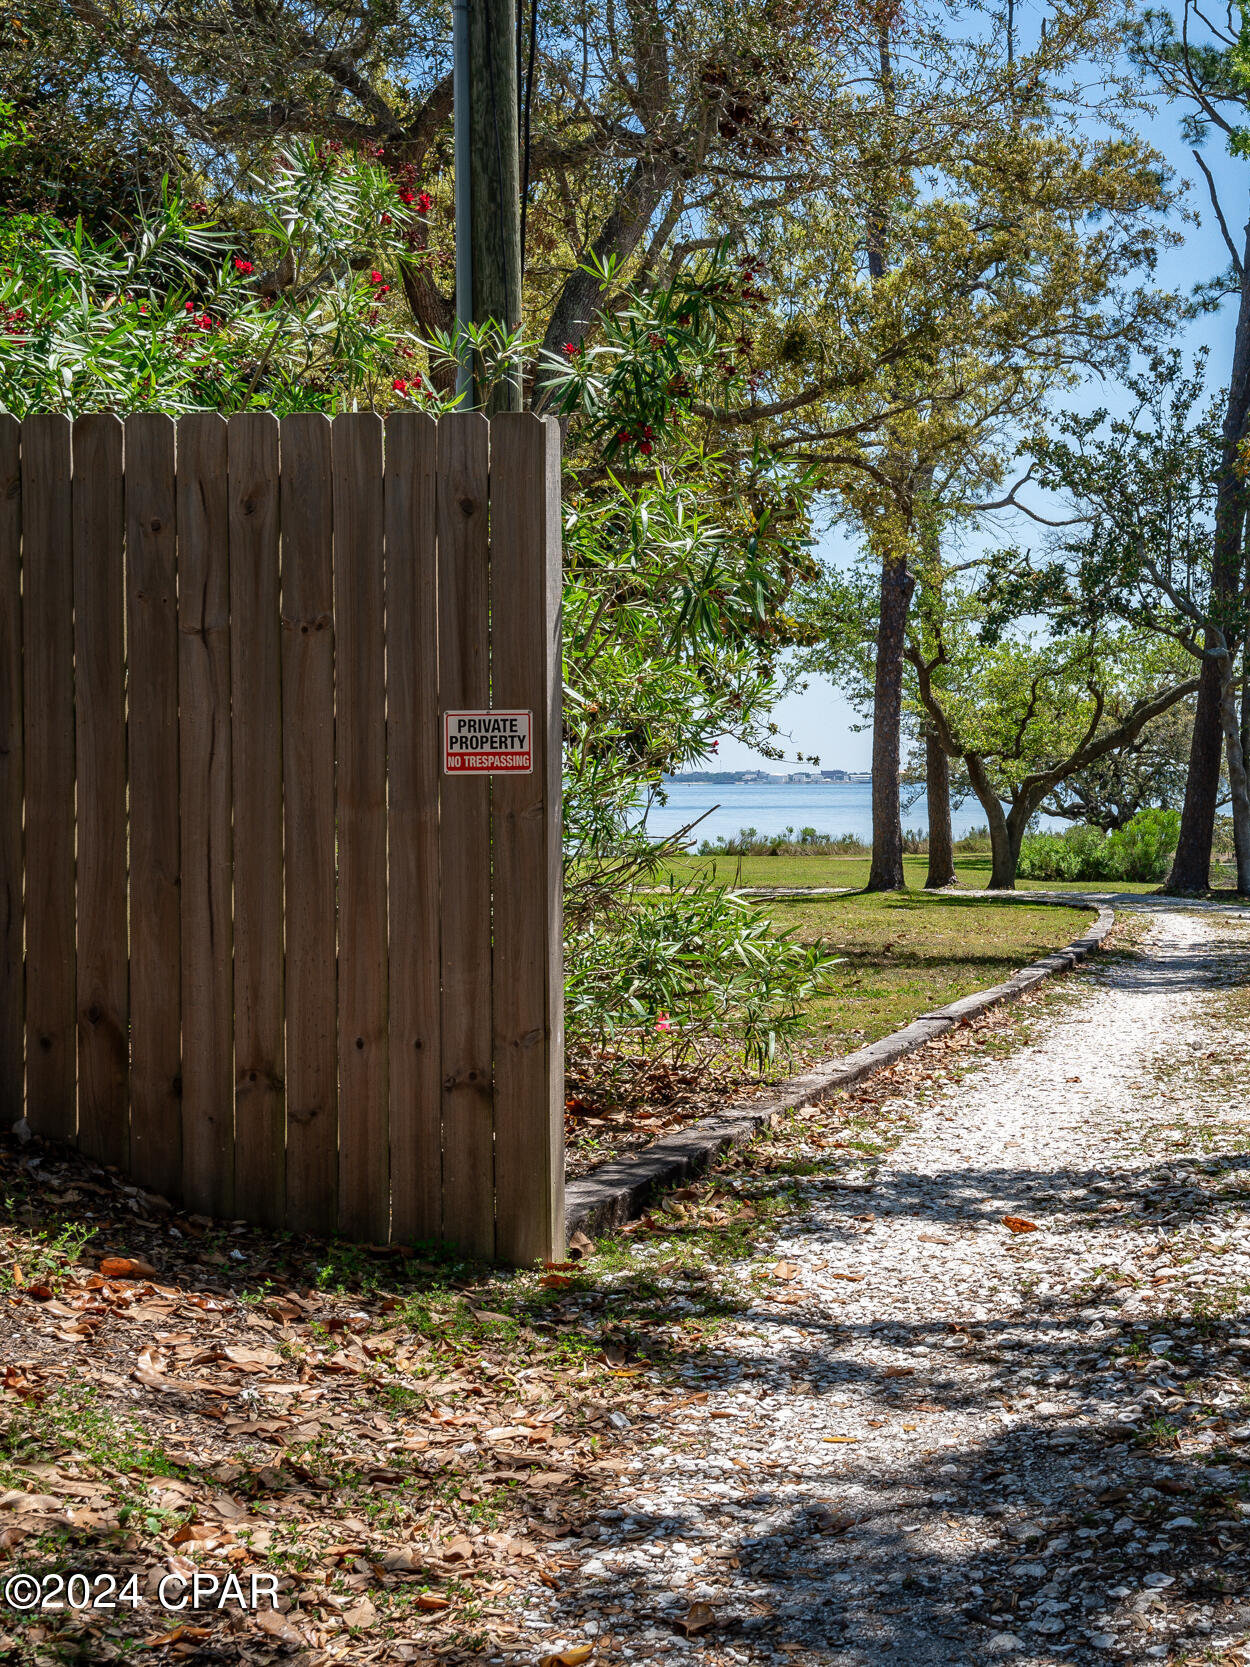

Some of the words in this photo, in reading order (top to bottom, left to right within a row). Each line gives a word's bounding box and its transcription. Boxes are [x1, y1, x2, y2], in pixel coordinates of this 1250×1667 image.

[458, 719, 518, 733] PRIVATE
[449, 735, 527, 750] PROPERTY
[447, 756, 461, 767] NO
[464, 755, 529, 767] TRESPASSING
